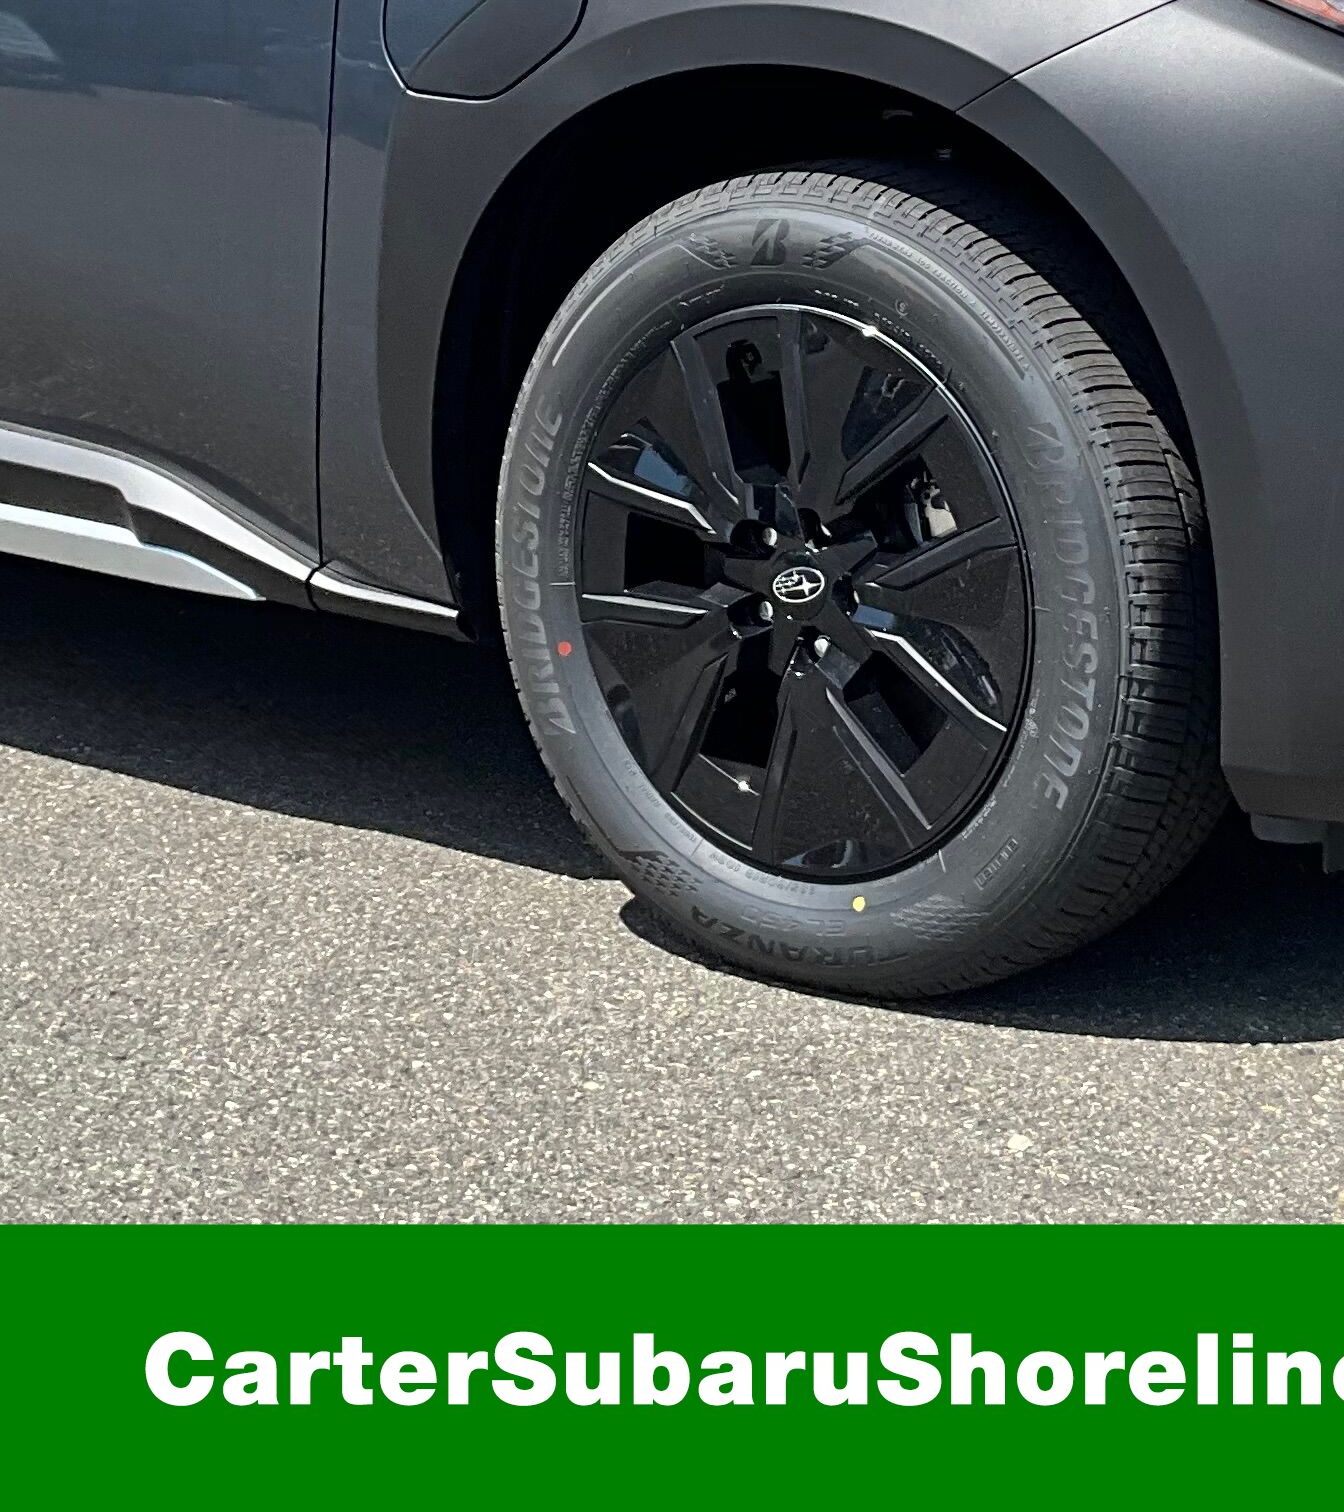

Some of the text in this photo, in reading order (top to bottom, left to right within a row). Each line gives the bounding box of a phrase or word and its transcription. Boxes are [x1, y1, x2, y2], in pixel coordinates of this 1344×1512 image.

[514, 393, 577, 737] BRIDGESTONE
[1025, 418, 1099, 813] BRIDGESTONE
[690, 905, 910, 968] TURANZA
